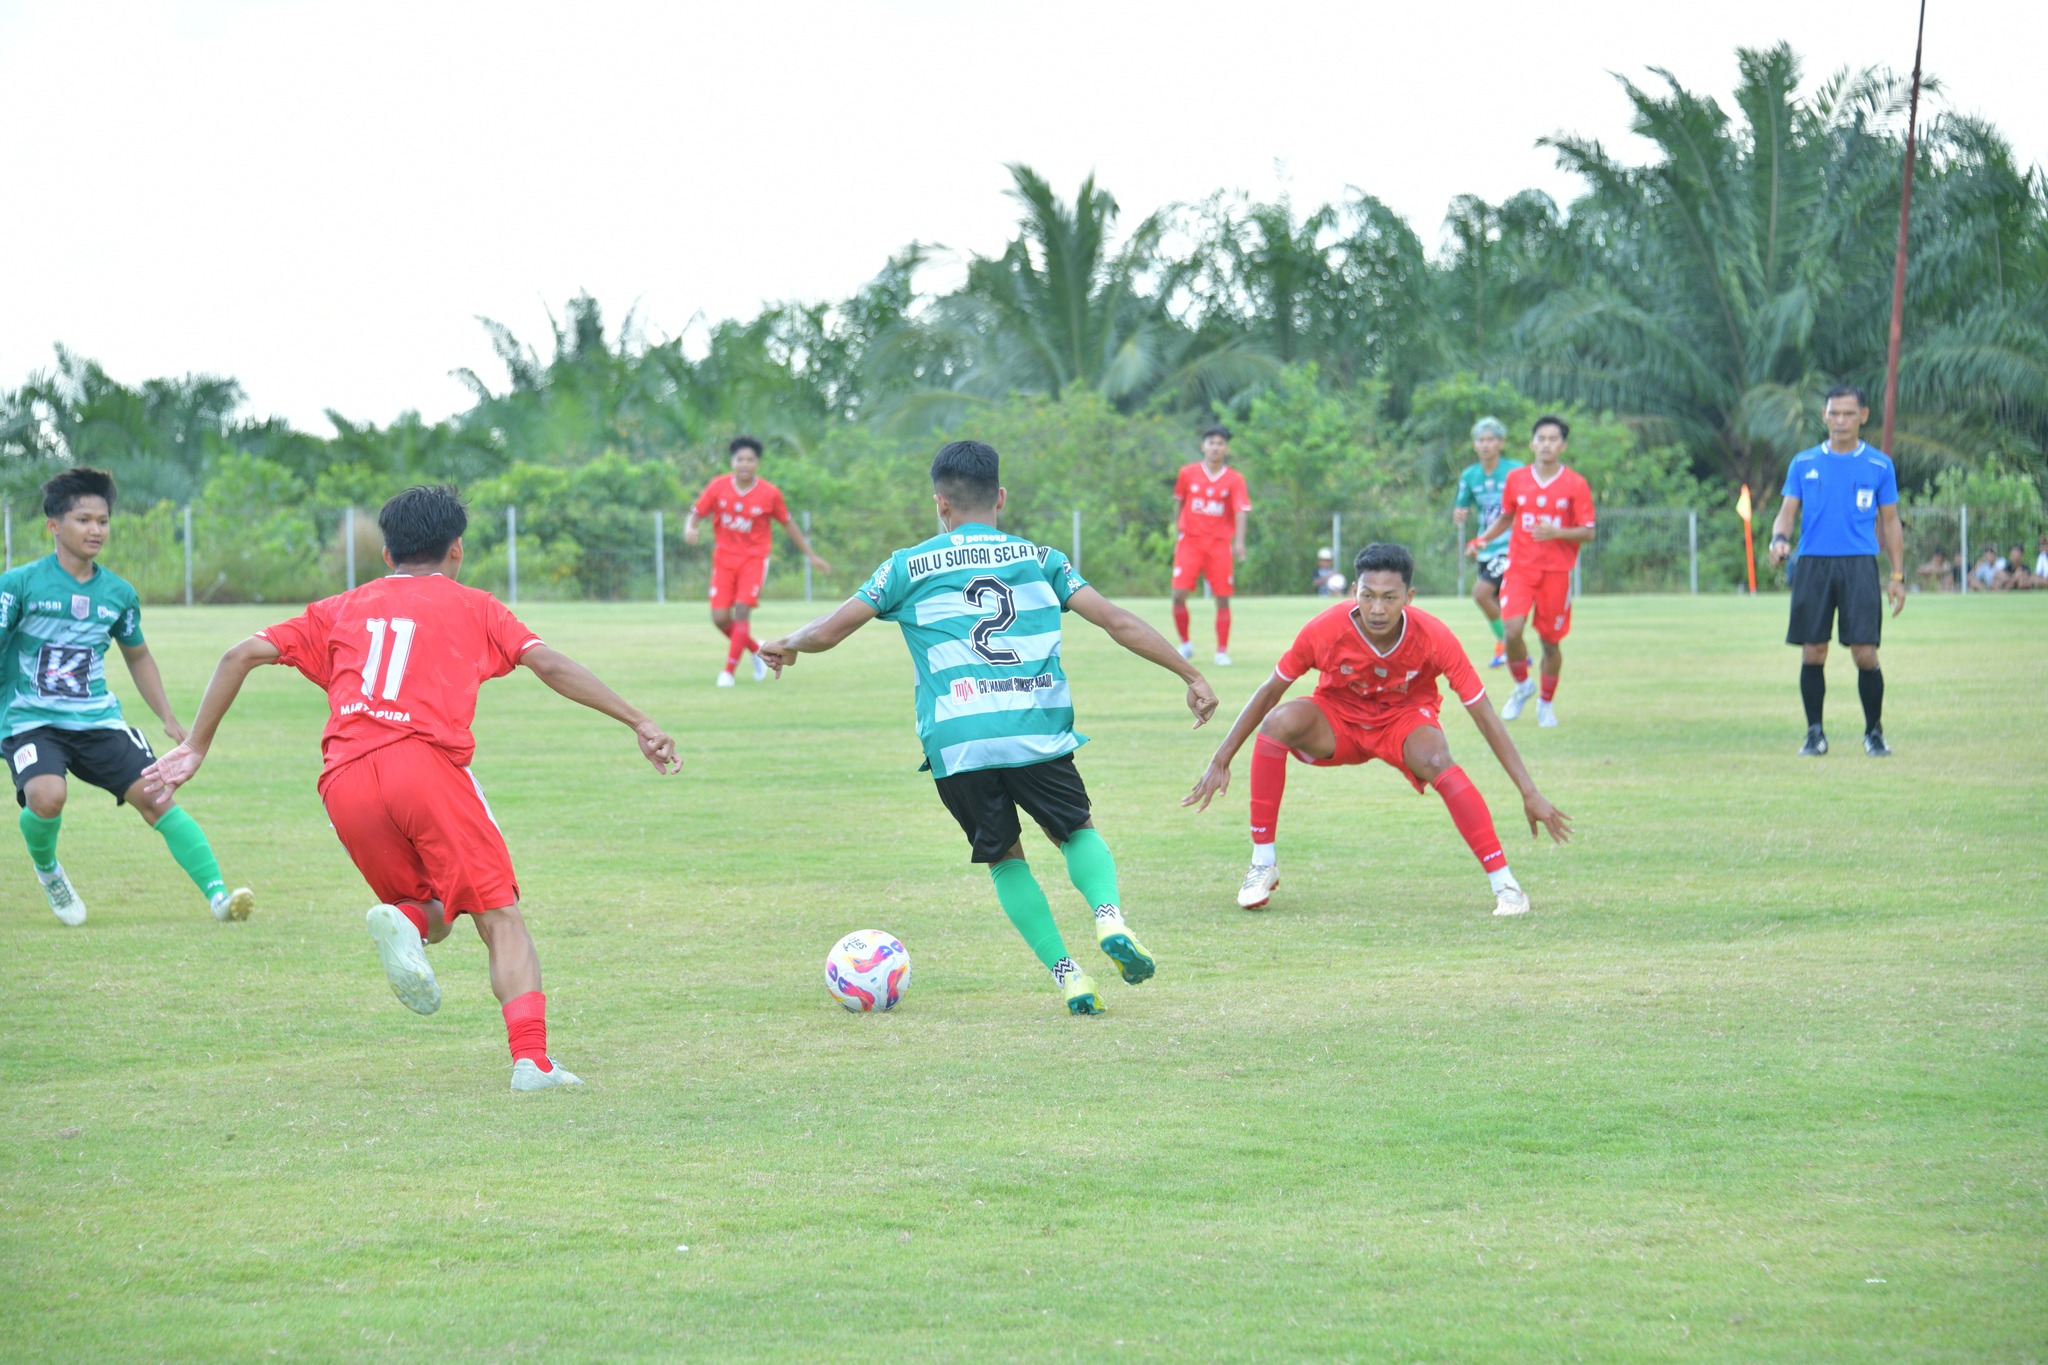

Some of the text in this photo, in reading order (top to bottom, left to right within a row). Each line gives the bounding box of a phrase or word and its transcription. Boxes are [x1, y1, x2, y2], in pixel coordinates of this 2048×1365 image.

[908, 552, 942, 578] HULU
[945, 547, 991, 568] SUNGAI
[361, 618, 416, 701] 11
[962, 575, 1023, 665] 2
